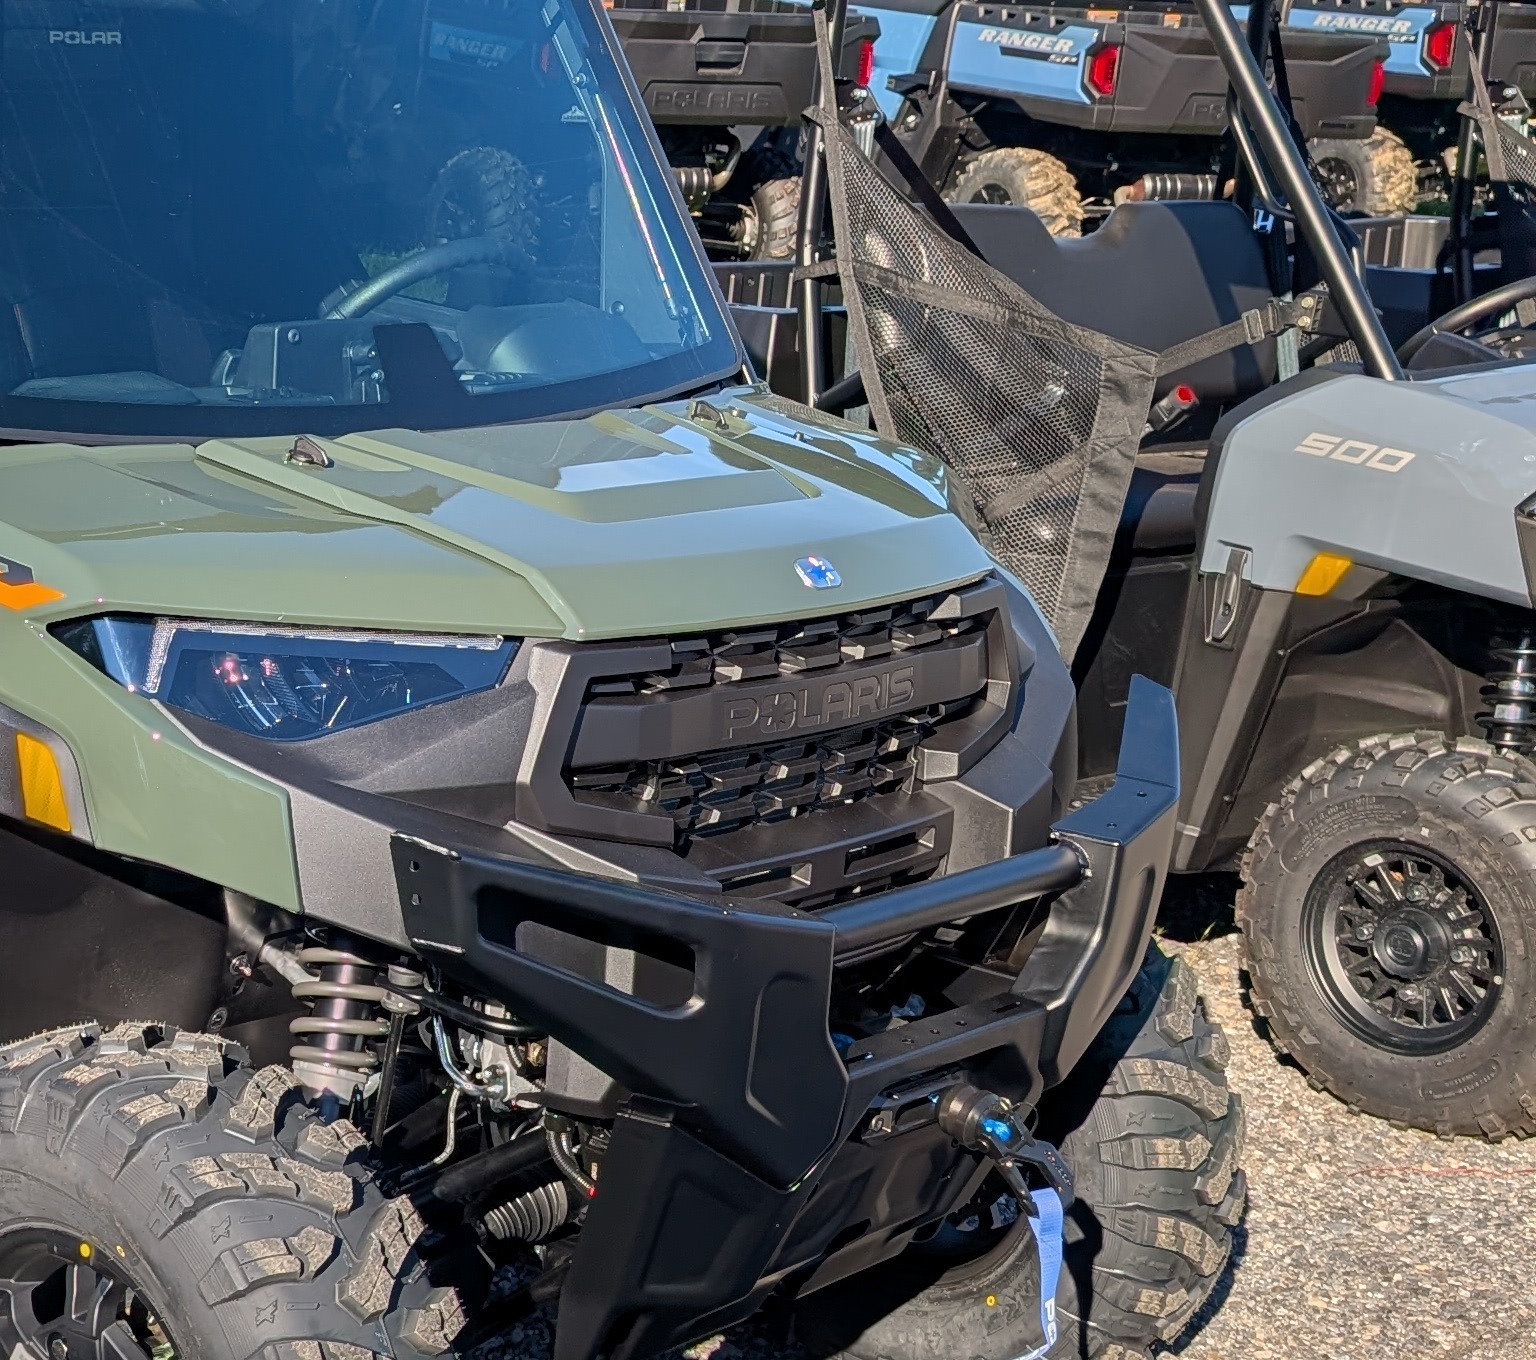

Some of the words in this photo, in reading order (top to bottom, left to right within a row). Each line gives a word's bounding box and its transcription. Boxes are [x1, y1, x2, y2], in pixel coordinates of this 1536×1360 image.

[1314, 14, 1411, 33] RANGER
[49, 30, 122, 45] POLAR
[977, 28, 1075, 53] RANGER
[1047, 53, 1078, 64] SP
[1294, 431, 1417, 473] 500
[720, 666, 915, 740] POLARIS
